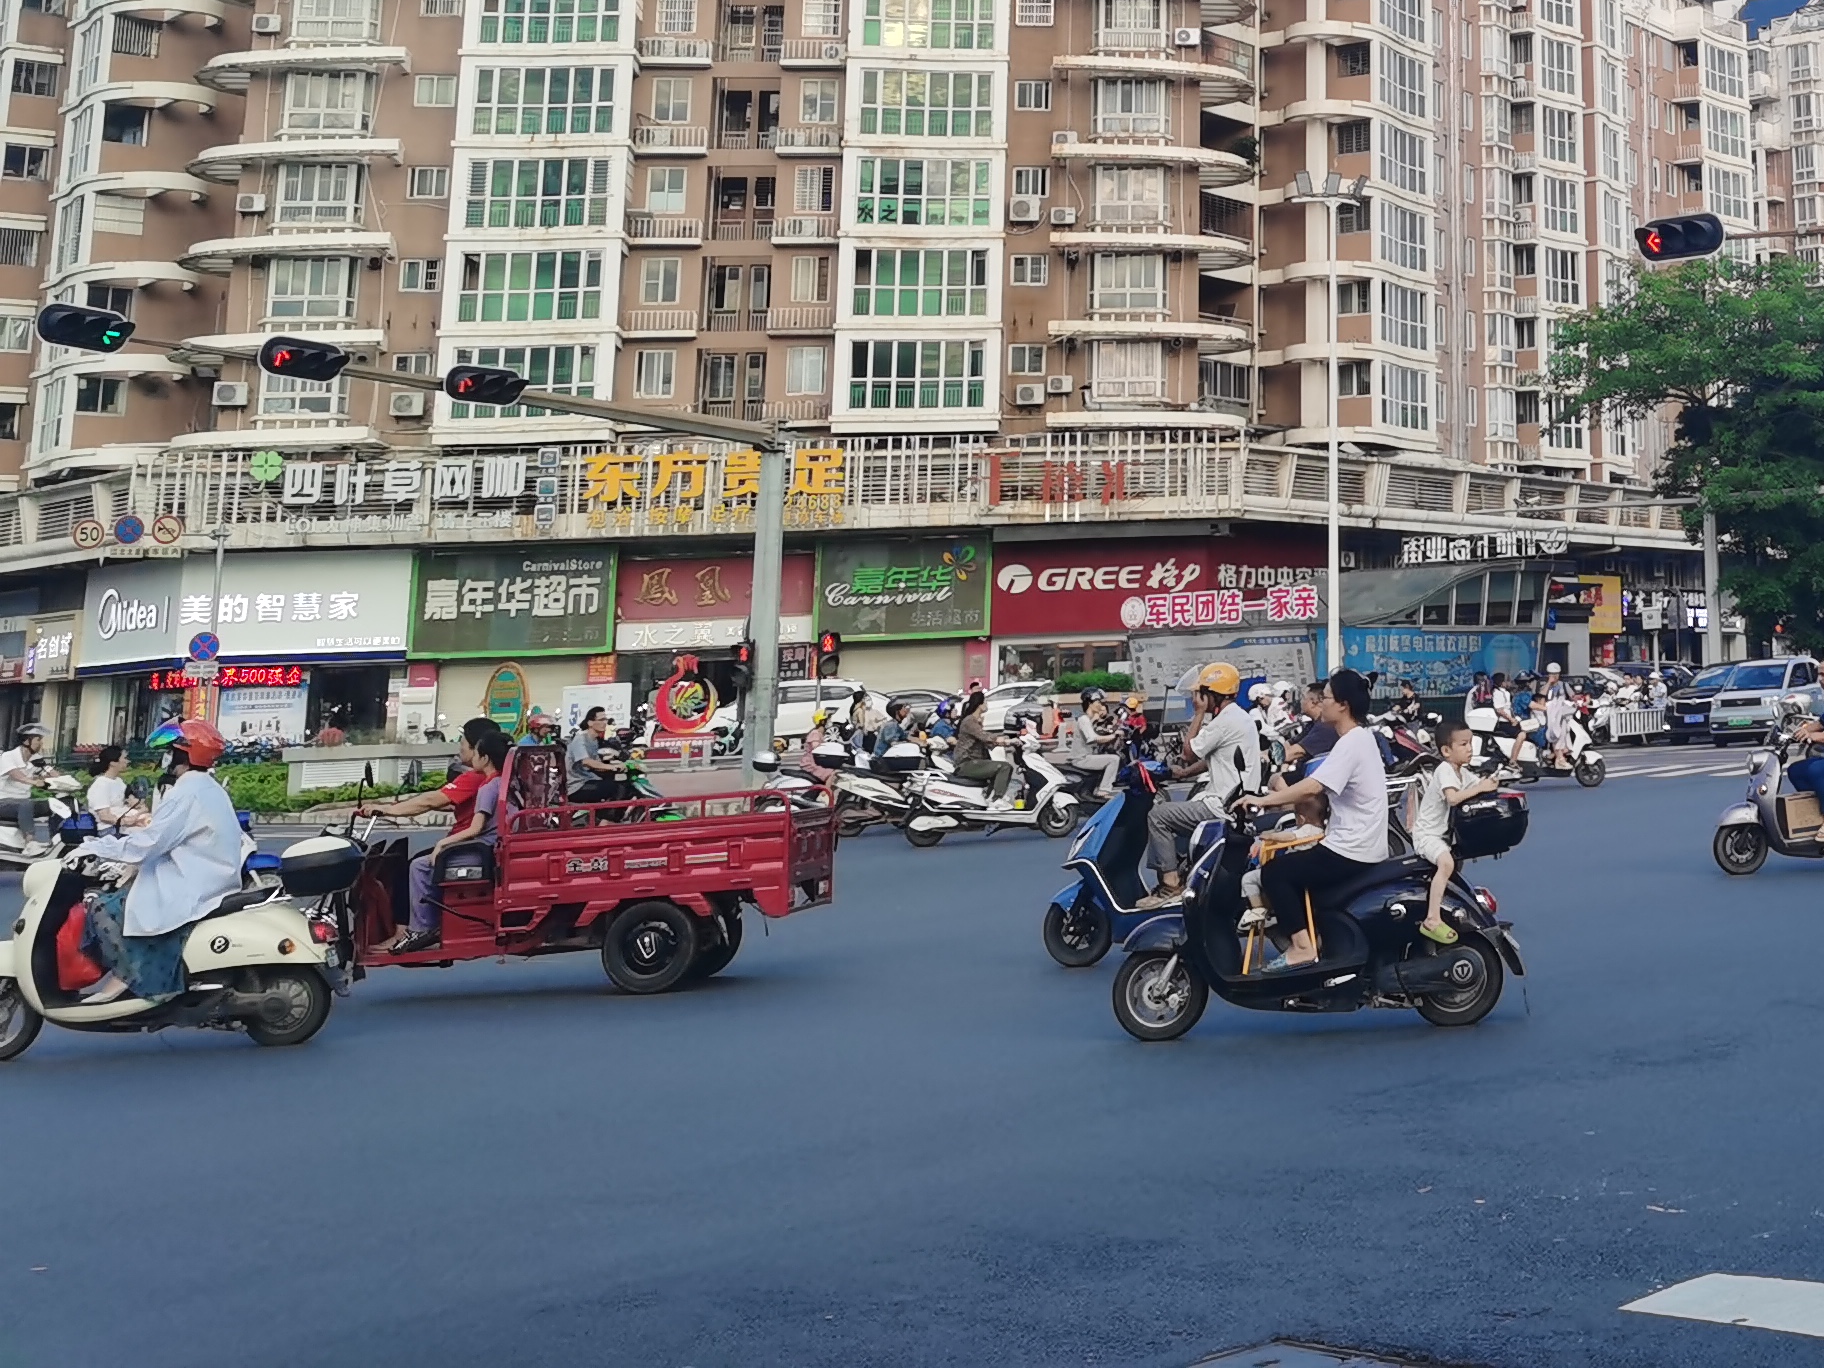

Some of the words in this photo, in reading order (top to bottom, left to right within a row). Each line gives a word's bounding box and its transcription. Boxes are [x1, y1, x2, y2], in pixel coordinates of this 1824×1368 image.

[283, 456, 527, 505] 四叶草网咖
[79, 527, 98, 542] 50
[523, 559, 603, 572] CarnivalStore
[850, 566, 953, 594] 嘉年华
[1037, 565, 1143, 591] GREE
[180, 591, 360, 625] 美的智慧家
[424, 575, 601, 620] 嘉年华超市
[825, 583, 952, 607] Carnival
[1144, 584, 1319, 628] 军民团结一家亲
[98, 588, 158, 640] Midea
